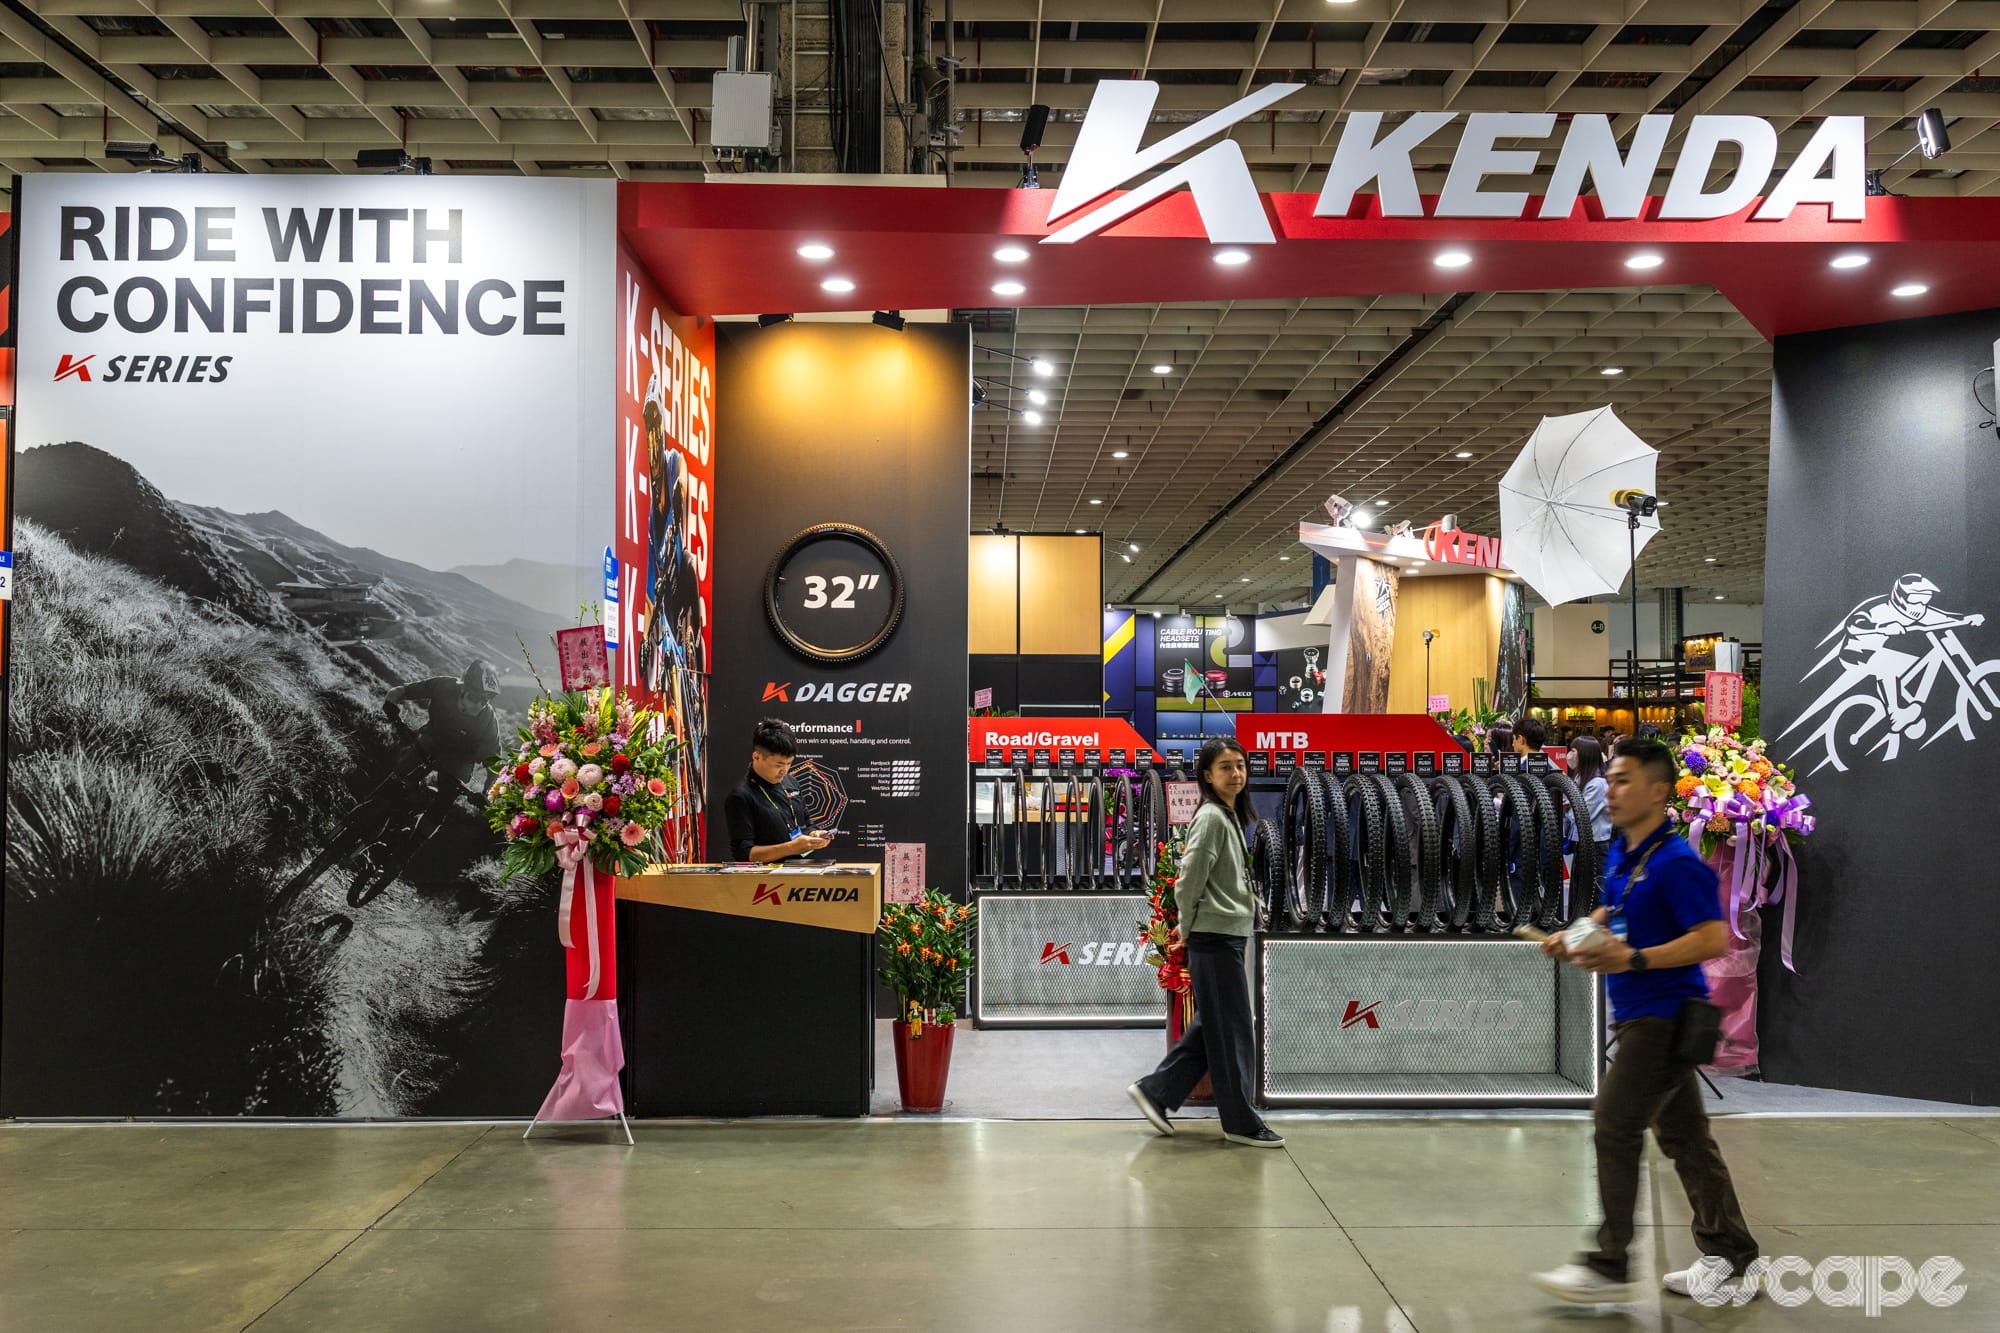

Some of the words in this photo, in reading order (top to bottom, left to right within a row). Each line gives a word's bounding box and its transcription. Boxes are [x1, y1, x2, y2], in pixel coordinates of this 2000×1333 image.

[1313, 111, 1865, 222] KENDA
[59, 205, 236, 262] RIDE
[261, 207, 463, 264] WITH
[56, 276, 565, 336] CONFIDENCE
[103, 354, 233, 383] SERIES
[794, 682, 912, 703] DAGGER
[829, 737, 848, 746] speed,
[850, 737, 875, 746] handling
[889, 737, 911, 745] control.
[985, 731, 1099, 747] Road/Gravel
[1256, 731, 1309, 749] MTB
[787, 887, 858, 902] KENDA
[1079, 941, 1148, 966] SERI
[1390, 1000, 1522, 1029] SERIES
